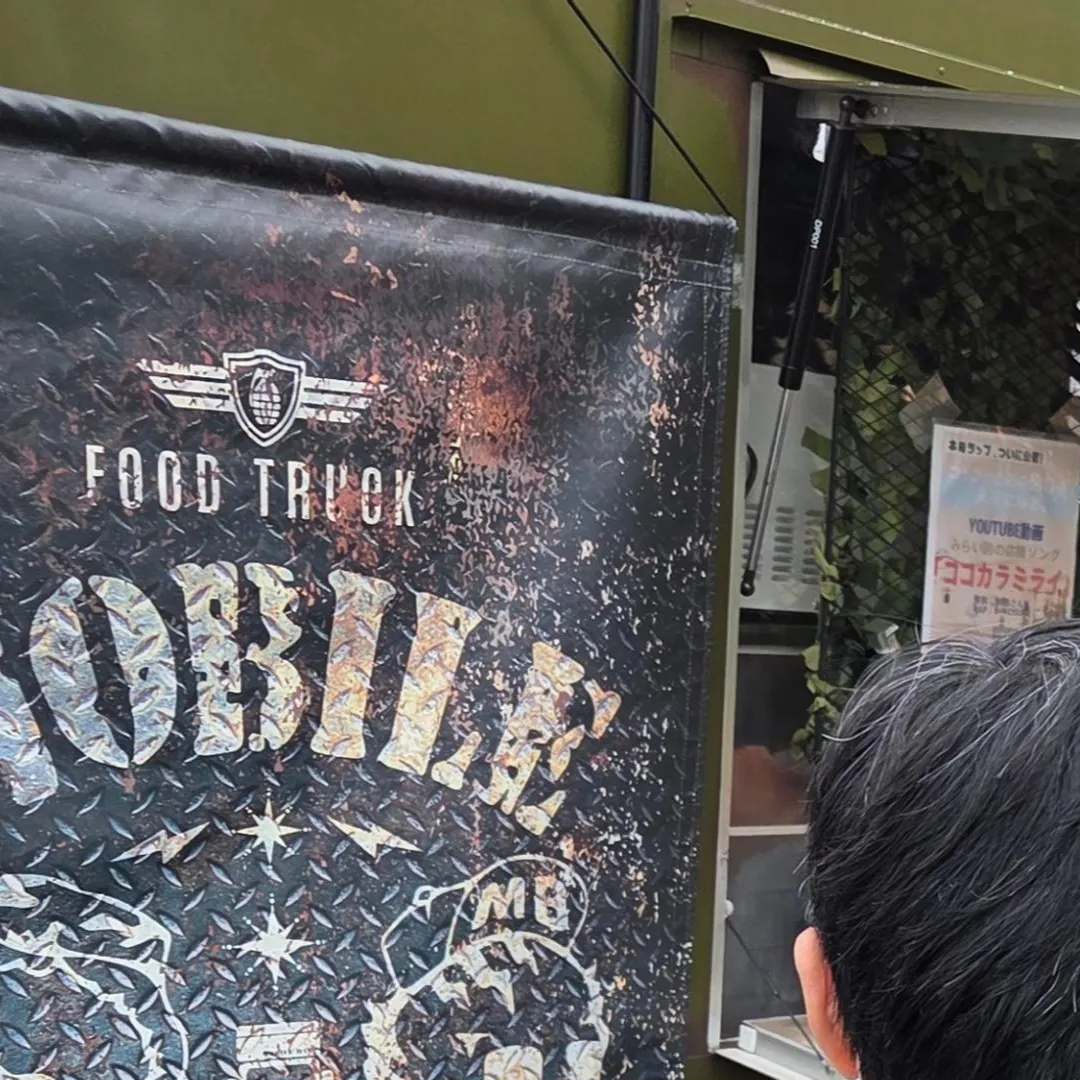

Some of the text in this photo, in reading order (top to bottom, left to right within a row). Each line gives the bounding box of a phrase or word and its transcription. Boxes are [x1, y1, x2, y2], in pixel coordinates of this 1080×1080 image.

[83, 443, 417, 528] FOOD TRUCK
[0, 561, 622, 836] OBILE
